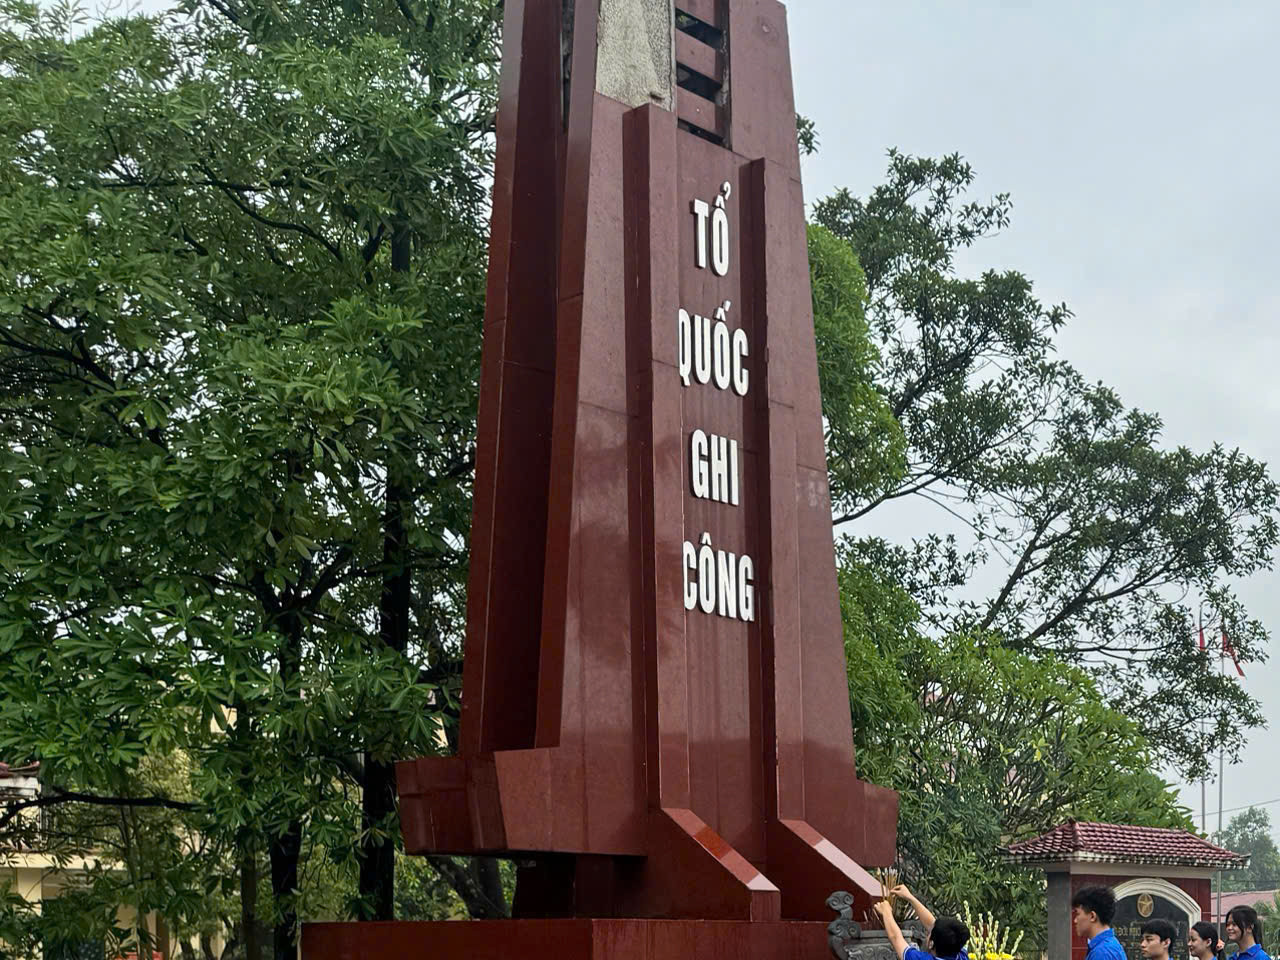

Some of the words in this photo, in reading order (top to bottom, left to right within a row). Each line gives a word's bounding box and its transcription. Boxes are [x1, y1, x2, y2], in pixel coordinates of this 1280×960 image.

[692, 180, 732, 278] TỔ
[677, 300, 750, 397] QUỐC
[690, 428, 740, 507] GHI
[682, 531, 756, 623] CÔNG
